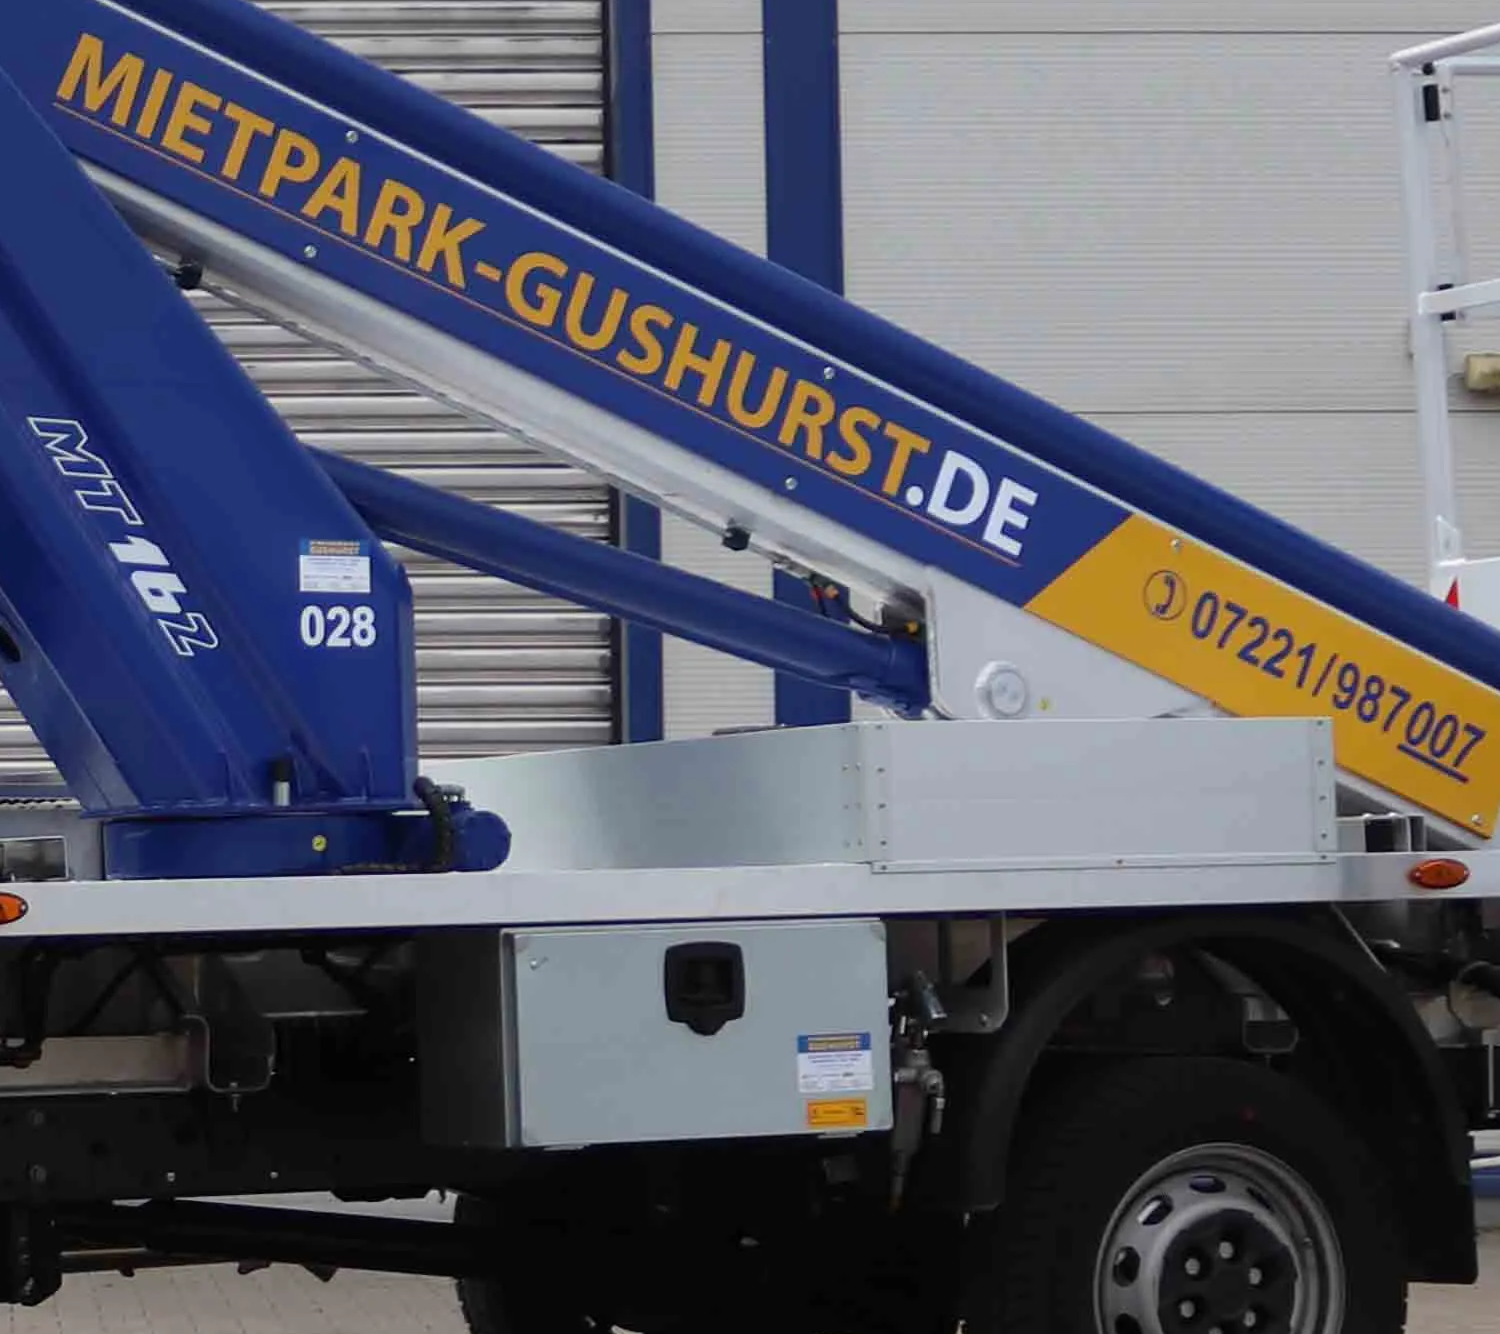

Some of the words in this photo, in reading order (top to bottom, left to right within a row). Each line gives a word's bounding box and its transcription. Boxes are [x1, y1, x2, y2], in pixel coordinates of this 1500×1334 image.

[55, 33, 1040, 556] MIETPARK-GUSHURST.DE
[27, 416, 146, 526] MT
[300, 604, 376, 647] 028
[1190, 590, 1487, 770] 07221/987007
